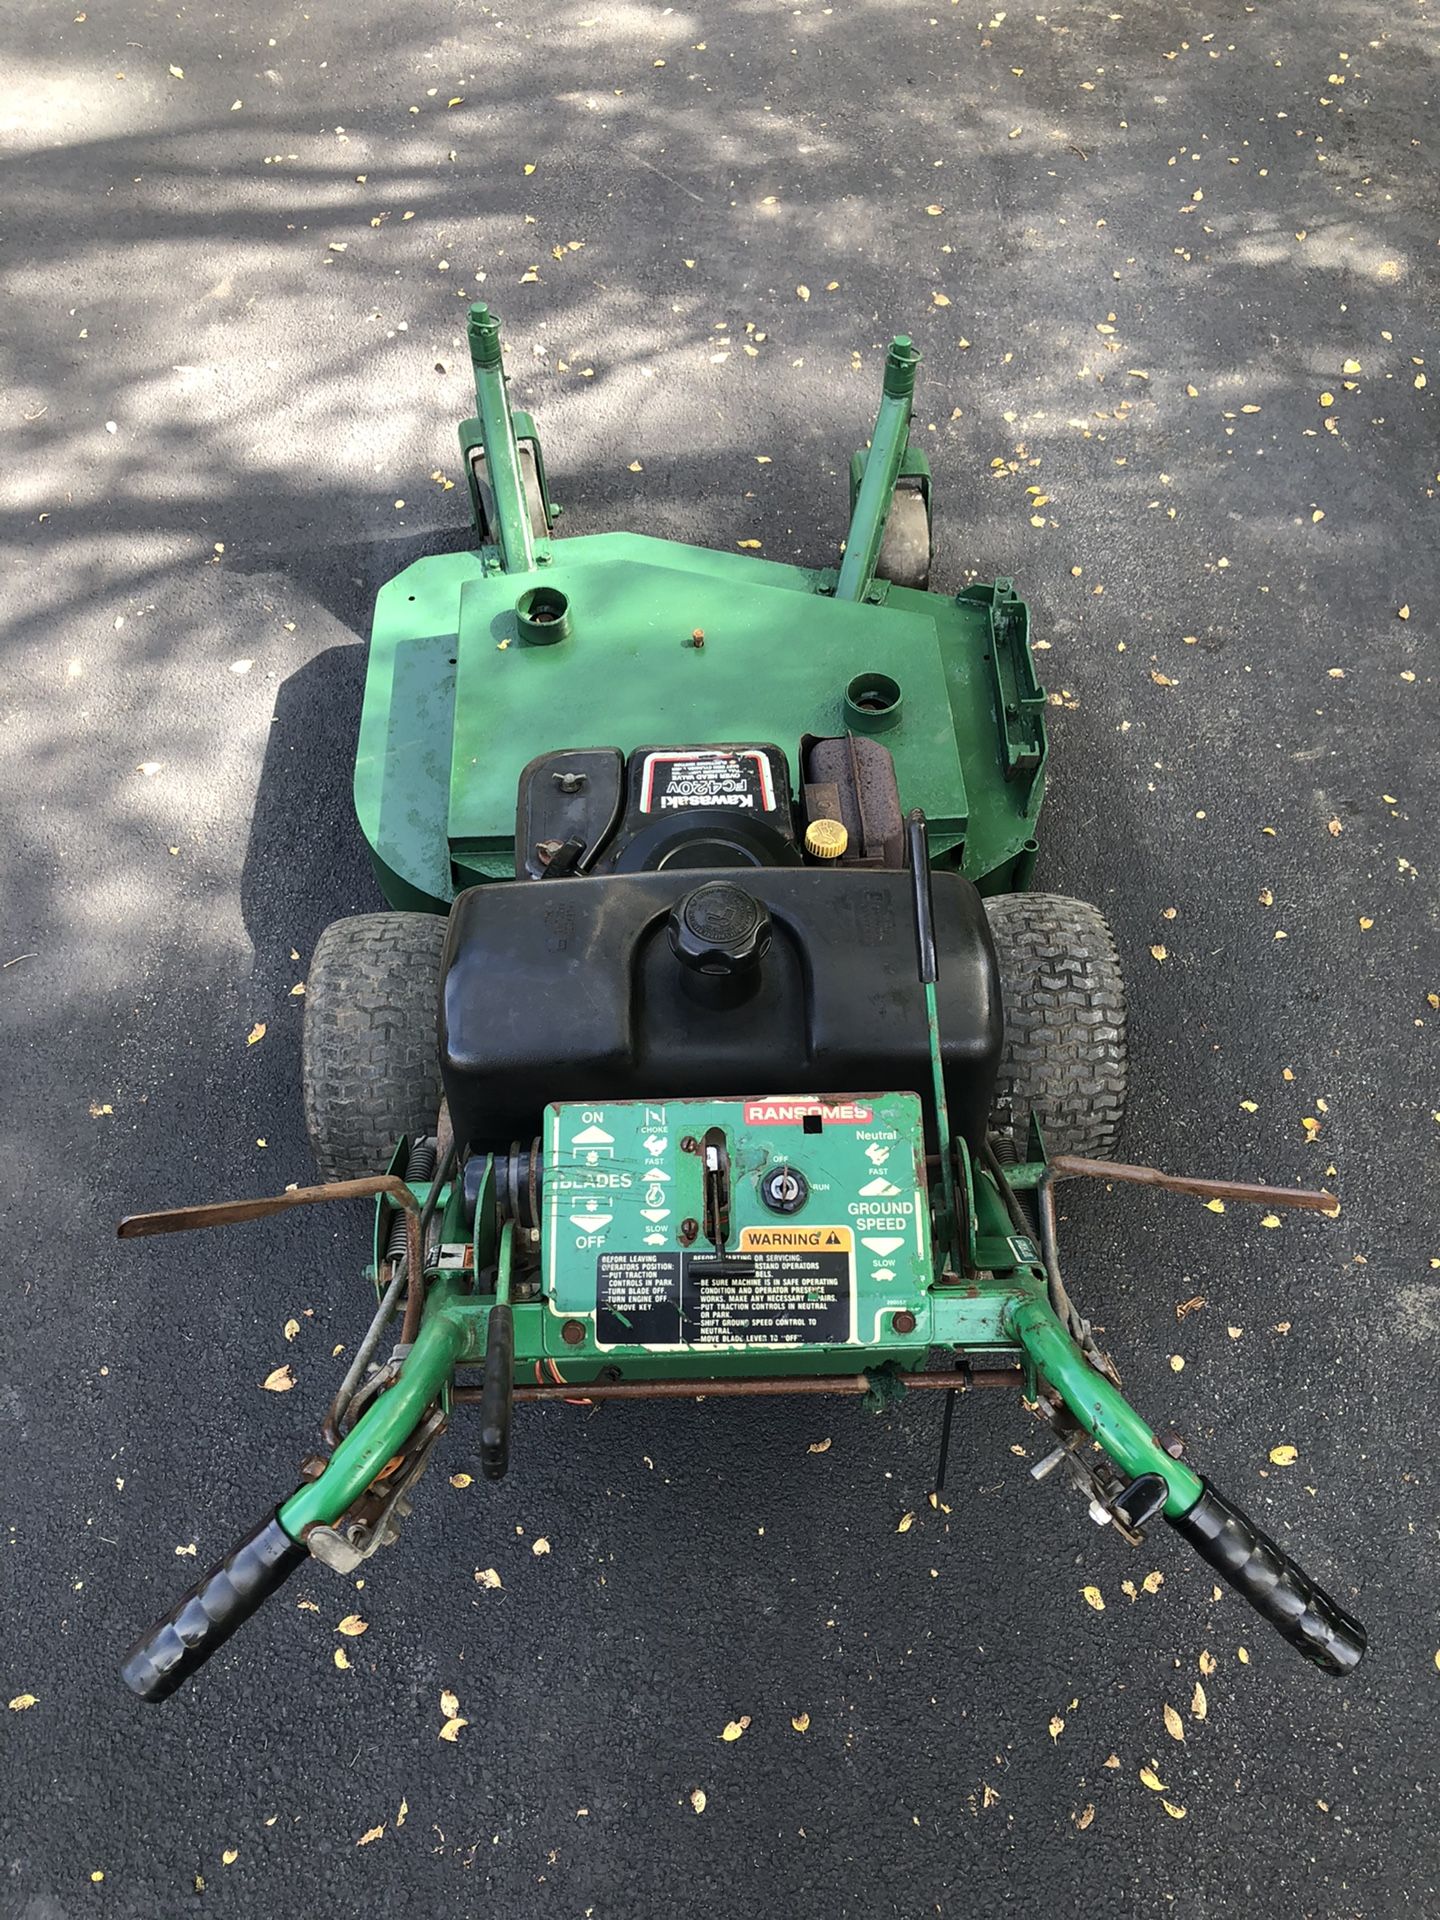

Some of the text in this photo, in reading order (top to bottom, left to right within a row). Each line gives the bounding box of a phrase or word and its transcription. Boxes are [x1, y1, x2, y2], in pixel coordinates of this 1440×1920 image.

[666, 780, 747, 795] FC420V
[661, 794, 753, 808] Kawasaki
[582, 1112, 603, 1123] ON
[749, 1106, 868, 1120] RANSOMES
[856, 1130, 897, 1140] Neutral
[560, 1174, 632, 1189] BLADES
[848, 1202, 913, 1215] GROUND
[856, 1218, 906, 1231] SPEED
[576, 1236, 606, 1249] OFF
[749, 1233, 820, 1245] WARNING
[629, 1255, 657, 1263] LEAVING
[766, 1254, 803, 1262] SERVICING:
[872, 1259, 896, 1267] SLOW
[601, 1263, 640, 1271] OPERATORS
[608, 1279, 643, 1287] CONTROLS
[628, 1287, 649, 1295] BLADE
[754, 1286, 789, 1294] OPERATOR
[628, 1295, 652, 1303] ENGINE
